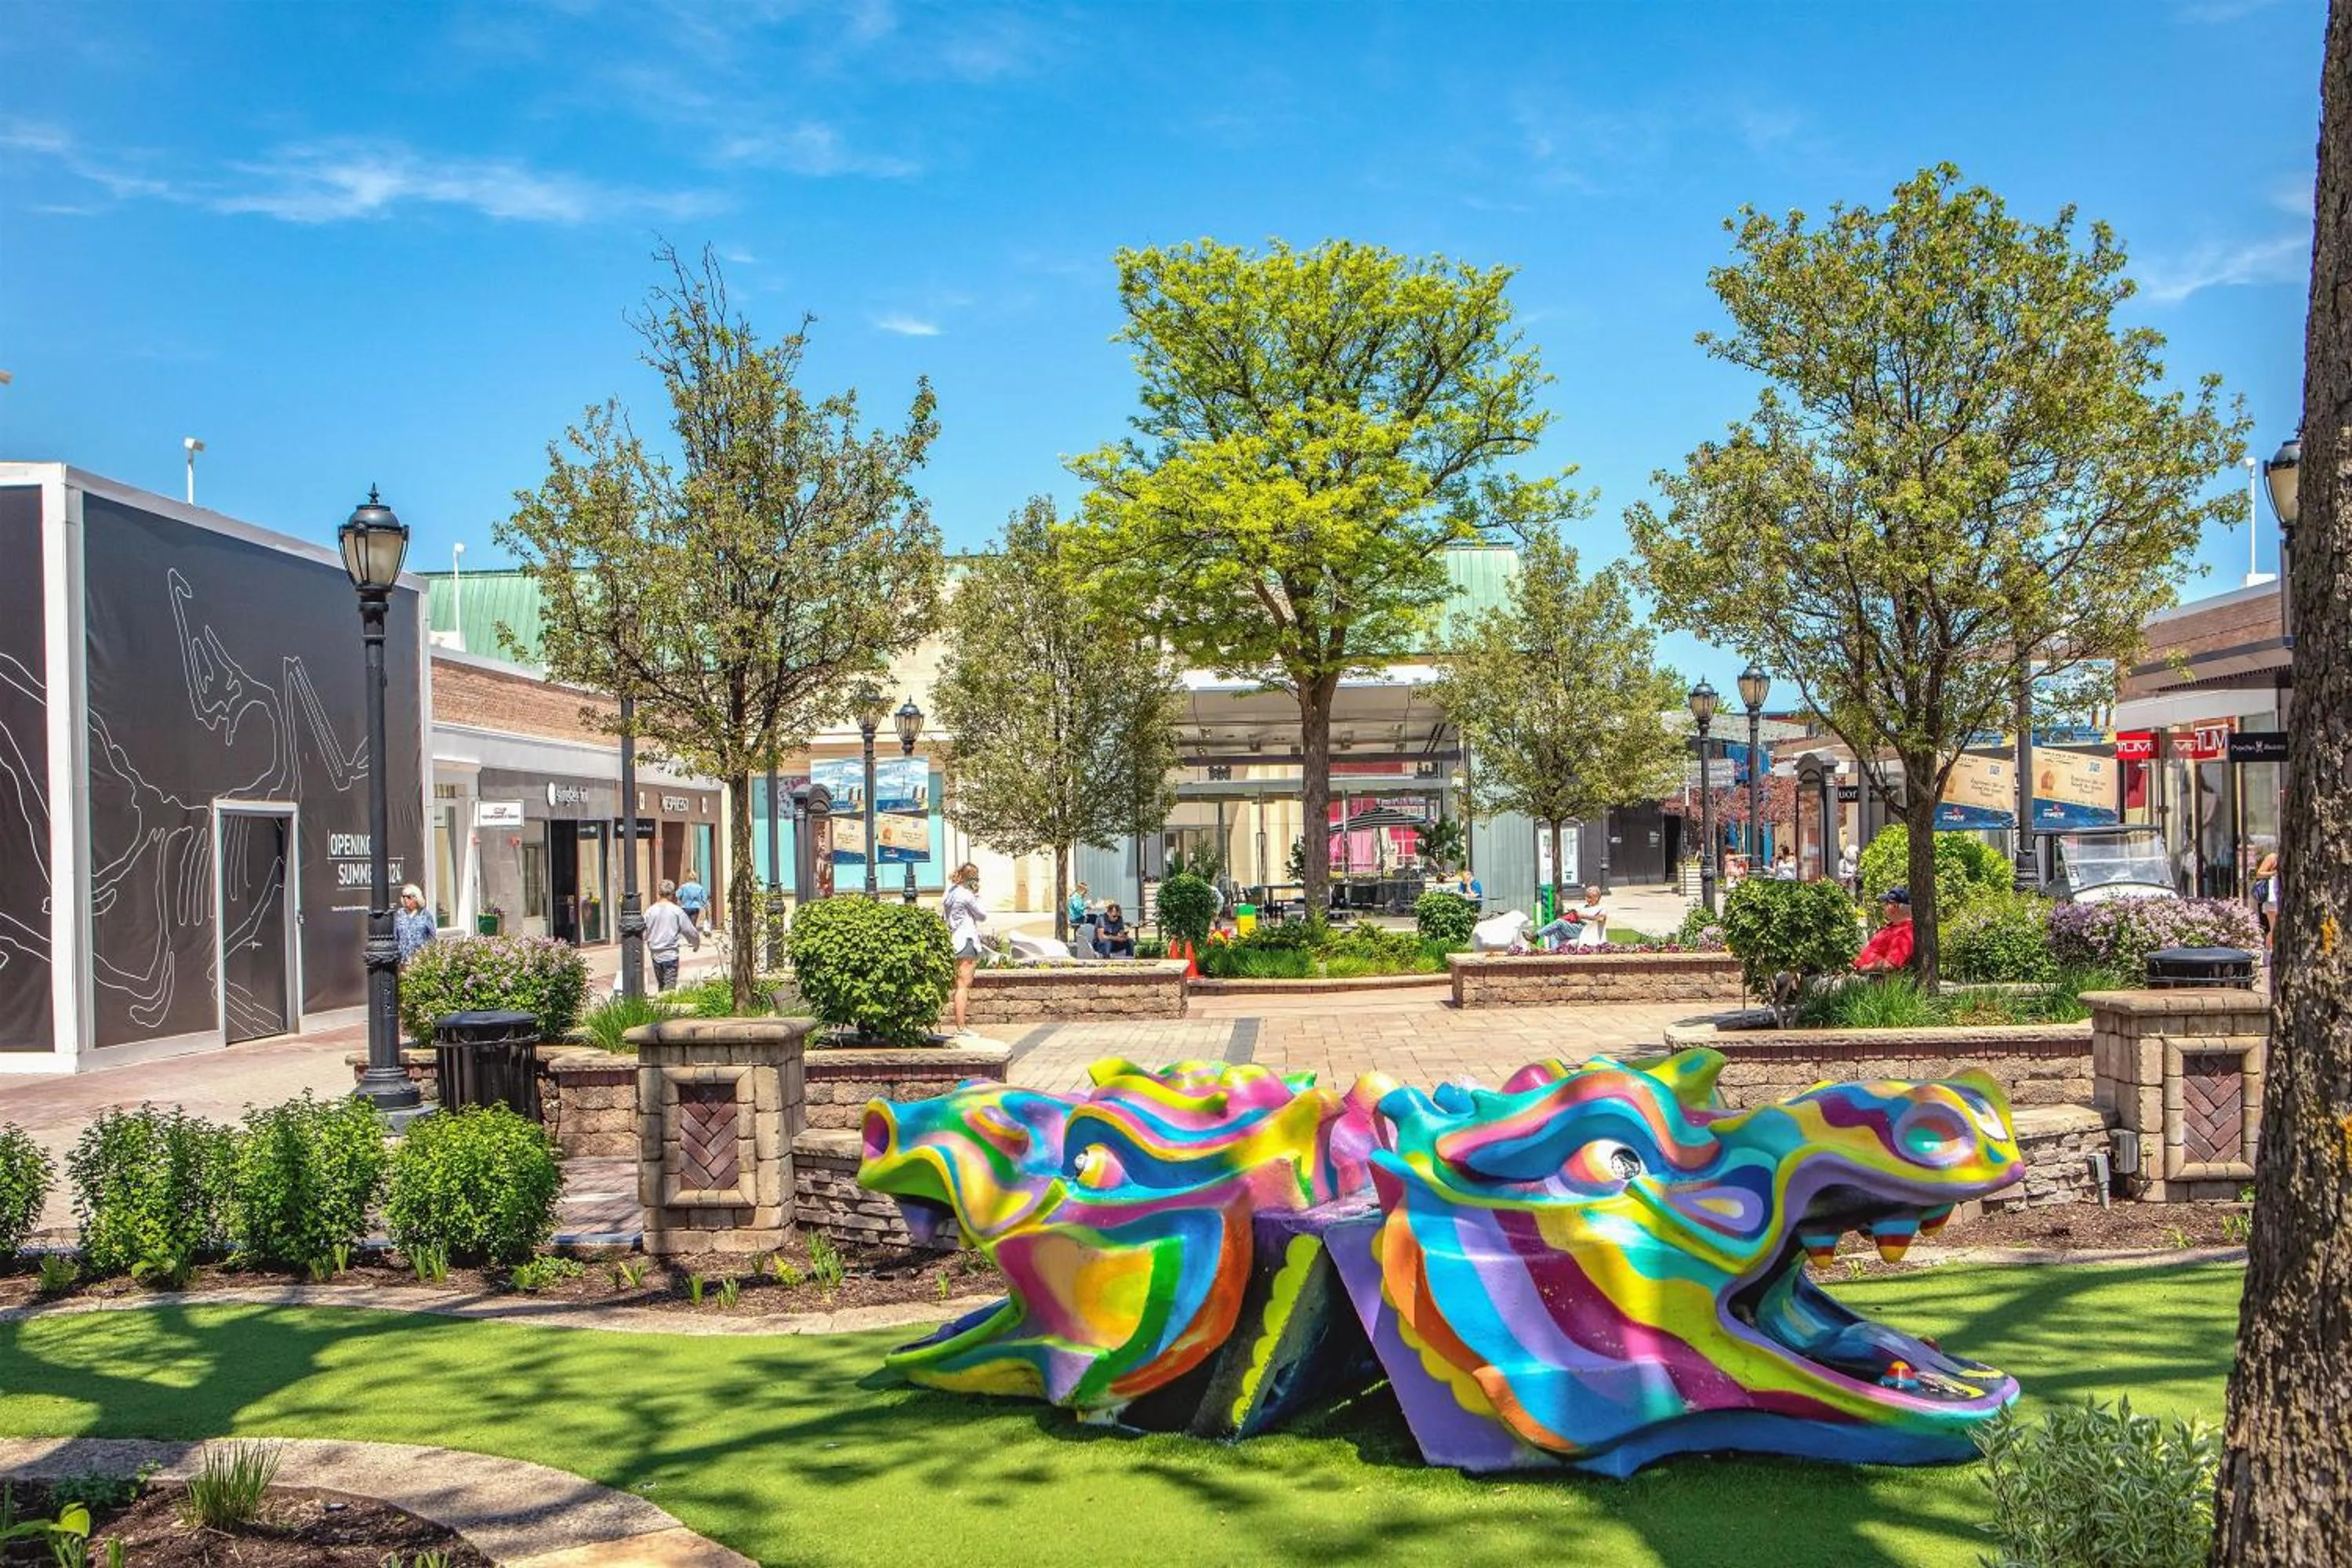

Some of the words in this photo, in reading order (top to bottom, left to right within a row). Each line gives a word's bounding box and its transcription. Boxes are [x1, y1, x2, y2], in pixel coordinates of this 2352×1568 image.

[2195, 724, 2228, 752] TUM
[338, 863, 372, 884] SUMME
[388, 863, 402, 884] 24
